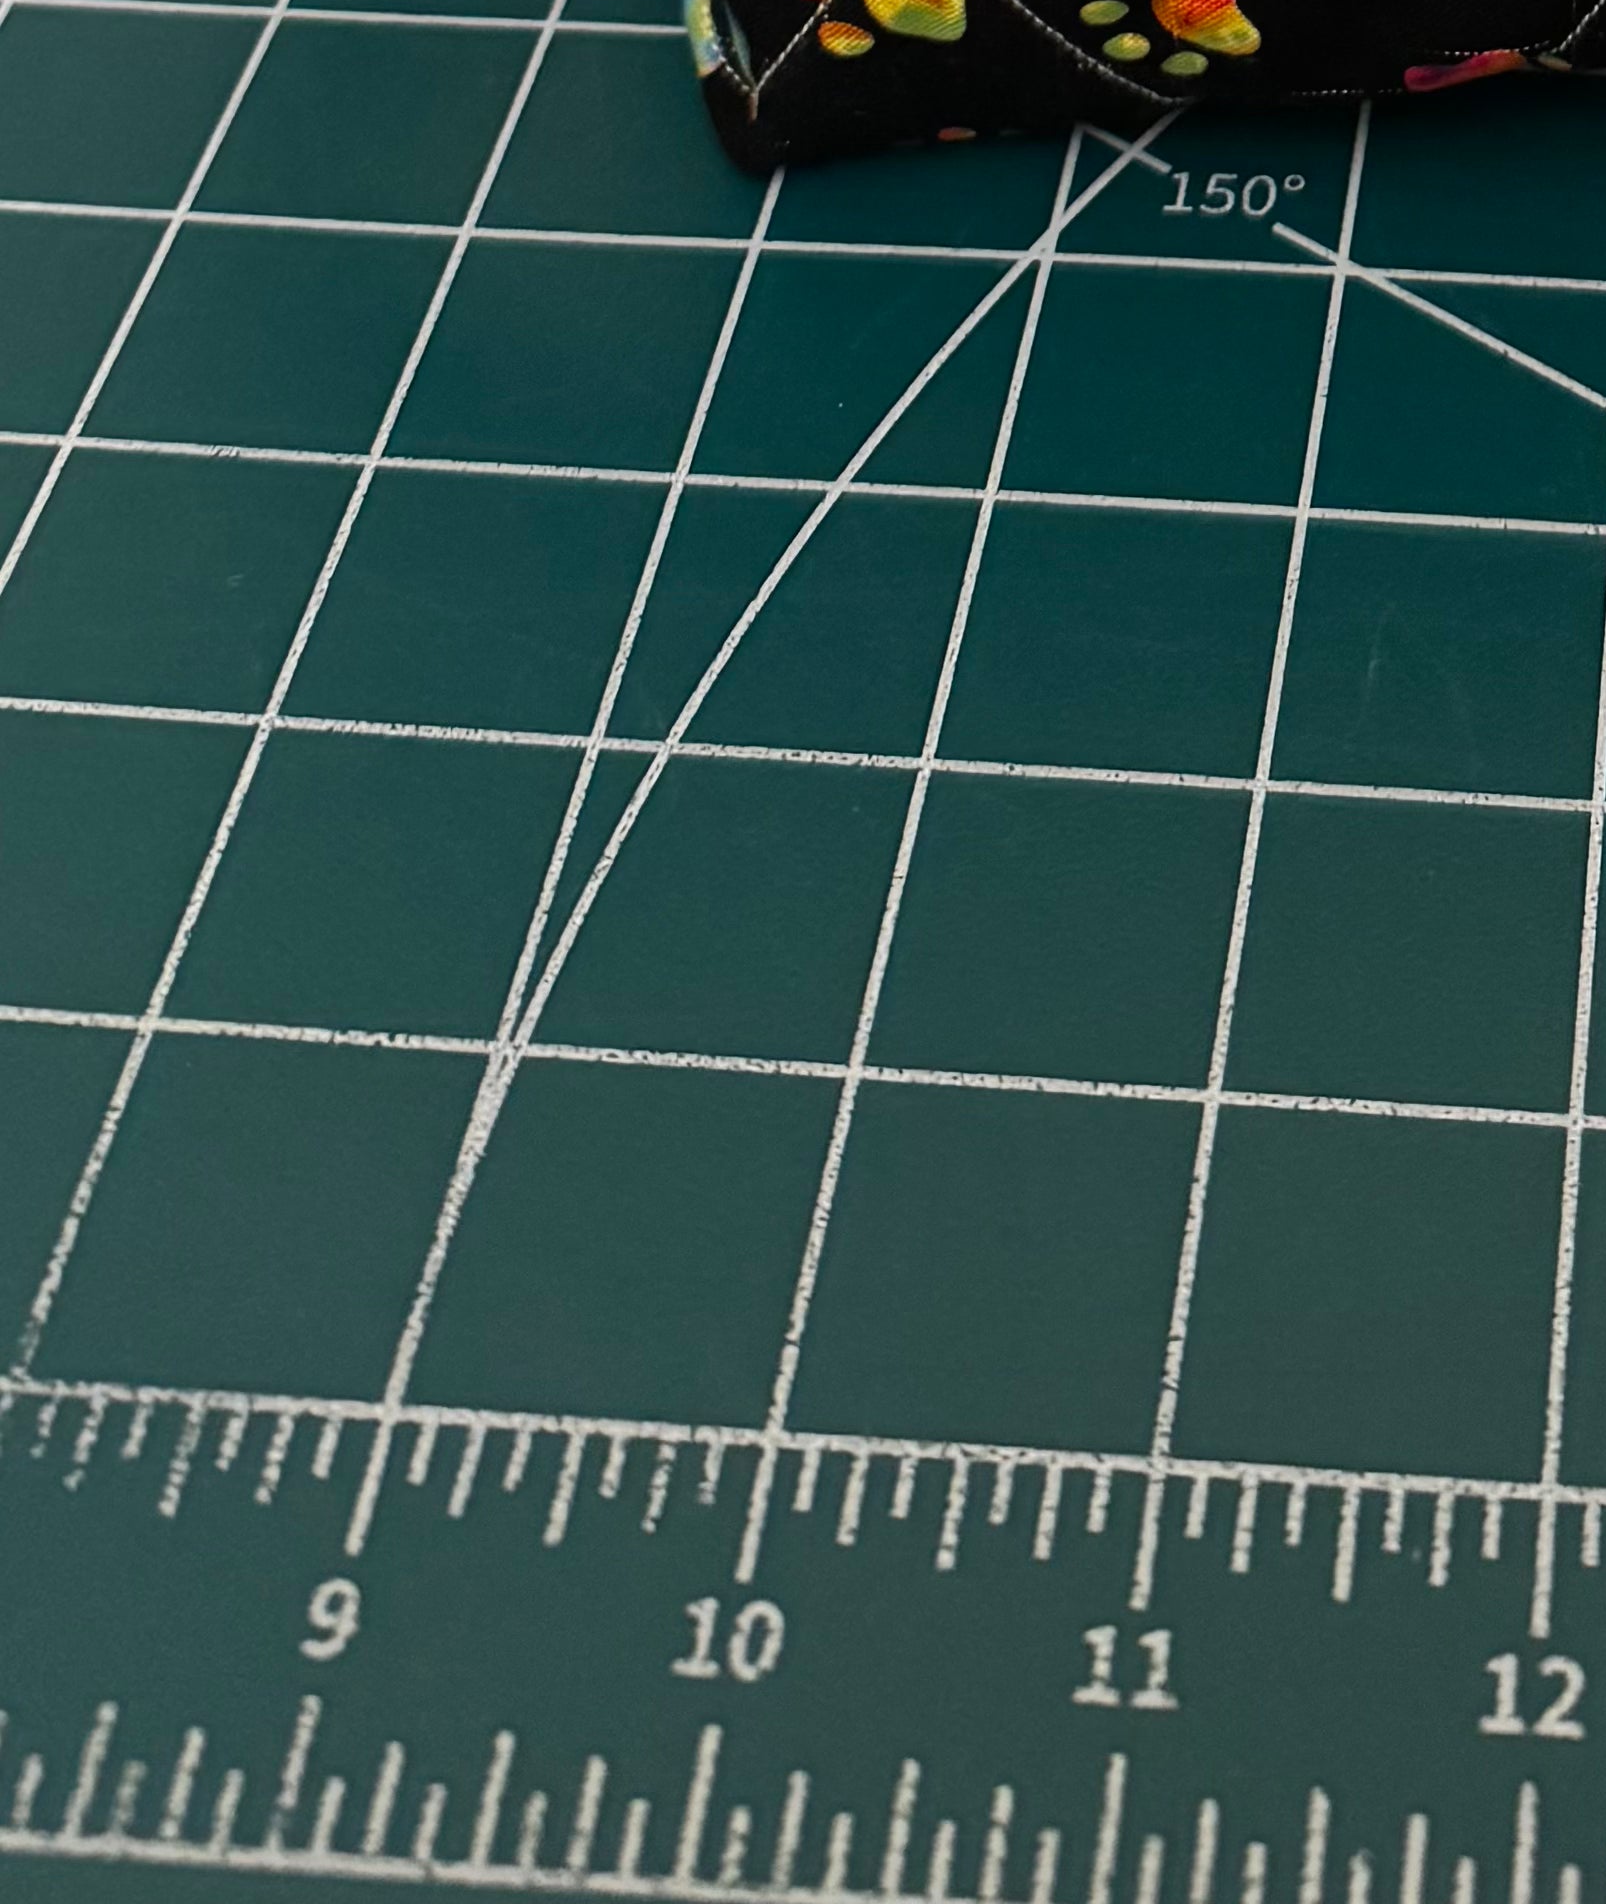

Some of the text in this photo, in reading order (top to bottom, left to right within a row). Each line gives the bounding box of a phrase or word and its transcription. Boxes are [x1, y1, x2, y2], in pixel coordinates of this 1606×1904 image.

[1162, 171, 1307, 217] 150°
[297, 1577, 361, 1662] 9
[669, 1595, 786, 1683] 10
[1070, 1624, 1180, 1710] 11
[1477, 1652, 1587, 1741] 12
